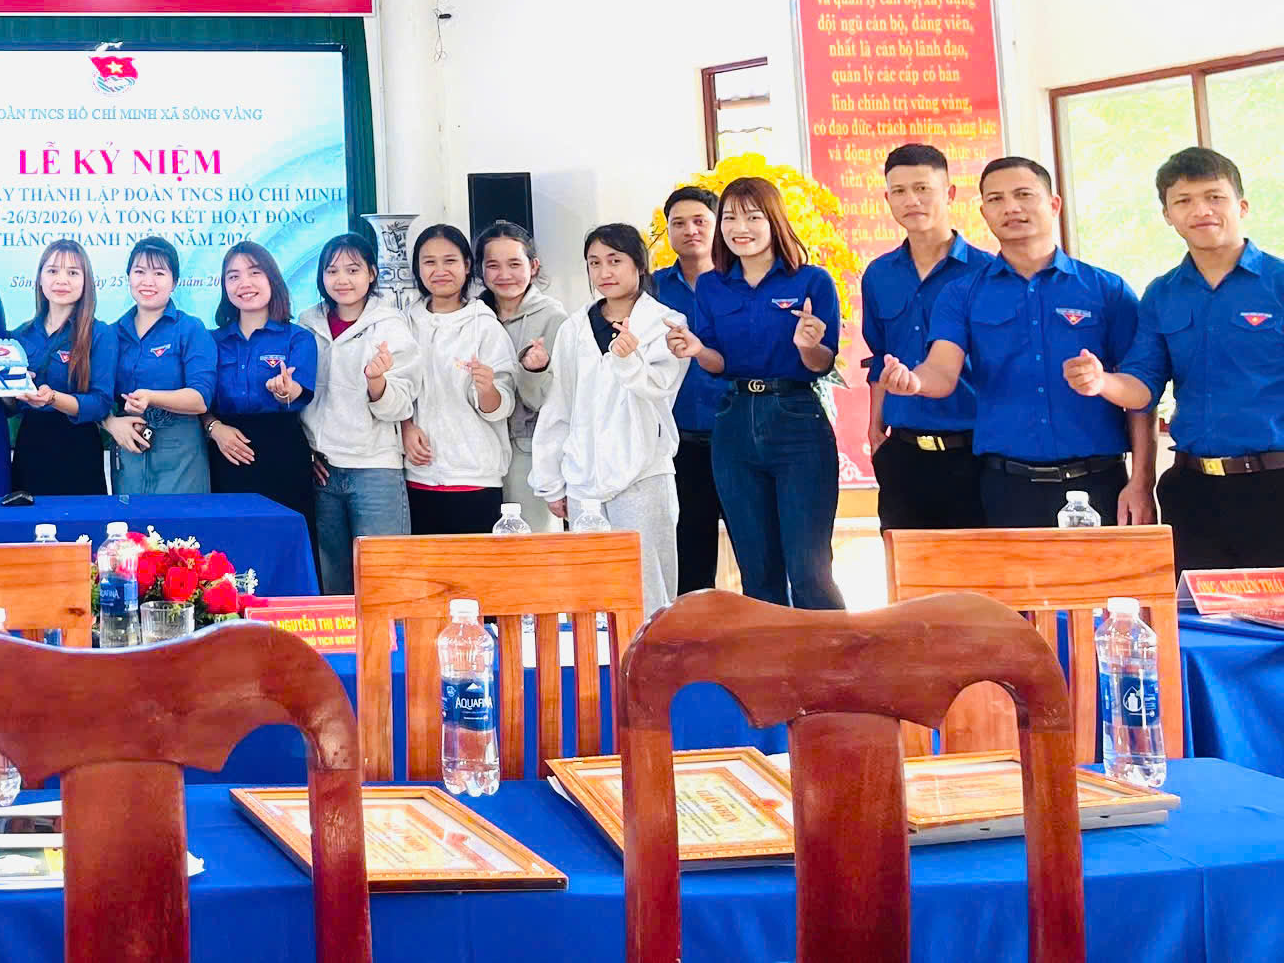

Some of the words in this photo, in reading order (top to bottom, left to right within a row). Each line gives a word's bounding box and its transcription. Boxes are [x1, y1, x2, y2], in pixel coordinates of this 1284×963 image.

[818, 14, 836, 35] đội
[840, 15, 863, 35] ngũ
[866, 14, 887, 32] cán
[889, 13, 908, 34] bộ,
[911, 13, 942, 34] đảng
[829, 38, 856, 57] nhất
[859, 39, 871, 57] là
[875, 39, 896, 57] cán
[898, 38, 913, 60] bộ
[915, 39, 940, 57] lãnh
[832, 64, 861, 85] quản
[863, 65, 874, 85] lý
[877, 65, 896, 82] các
[899, 64, 919, 85] cấp
[922, 65, 936, 82] có
[938, 65, 960, 82] bản
[29, 109, 65, 120] TNCS
[67, 106, 89, 120] HỒ
[91, 106, 117, 120] CHÍ
[119, 109, 157, 120] MINH
[160, 106, 180, 120] XÃ
[182, 106, 221, 121] SÔNG
[222, 106, 263, 121] VÀNG
[831, 93, 855, 111] lĩnh
[858, 93, 890, 111] chính
[892, 95, 909, 115] trị
[911, 95, 939, 114] vững
[813, 118, 826, 136] có
[829, 119, 849, 140] đạo
[877, 118, 907, 136] trách
[949, 118, 976, 141] năng
[18, 141, 60, 174] LỄ
[73, 141, 120, 174] KỶ
[132, 144, 223, 182] NIỆM
[828, 144, 842, 161] và
[19, 184, 80, 202] THÀNH
[87, 184, 120, 205] LẬP
[124, 184, 173, 202] ĐOÀN
[178, 188, 223, 202] TNCS
[229, 184, 254, 202] HỒ
[259, 184, 290, 202] CHÍ
[295, 188, 342, 202] MINH
[87, 206, 112, 224] VÀ
[116, 206, 165, 224] TỔNG
[171, 206, 207, 224] KẾT
[212, 209, 261, 228] HOẠT
[266, 206, 316, 228] ĐỘNG
[173, 229, 213, 246] NĂM
[10, 276, 36, 288] Sôn
[110, 276, 123, 287] 25
